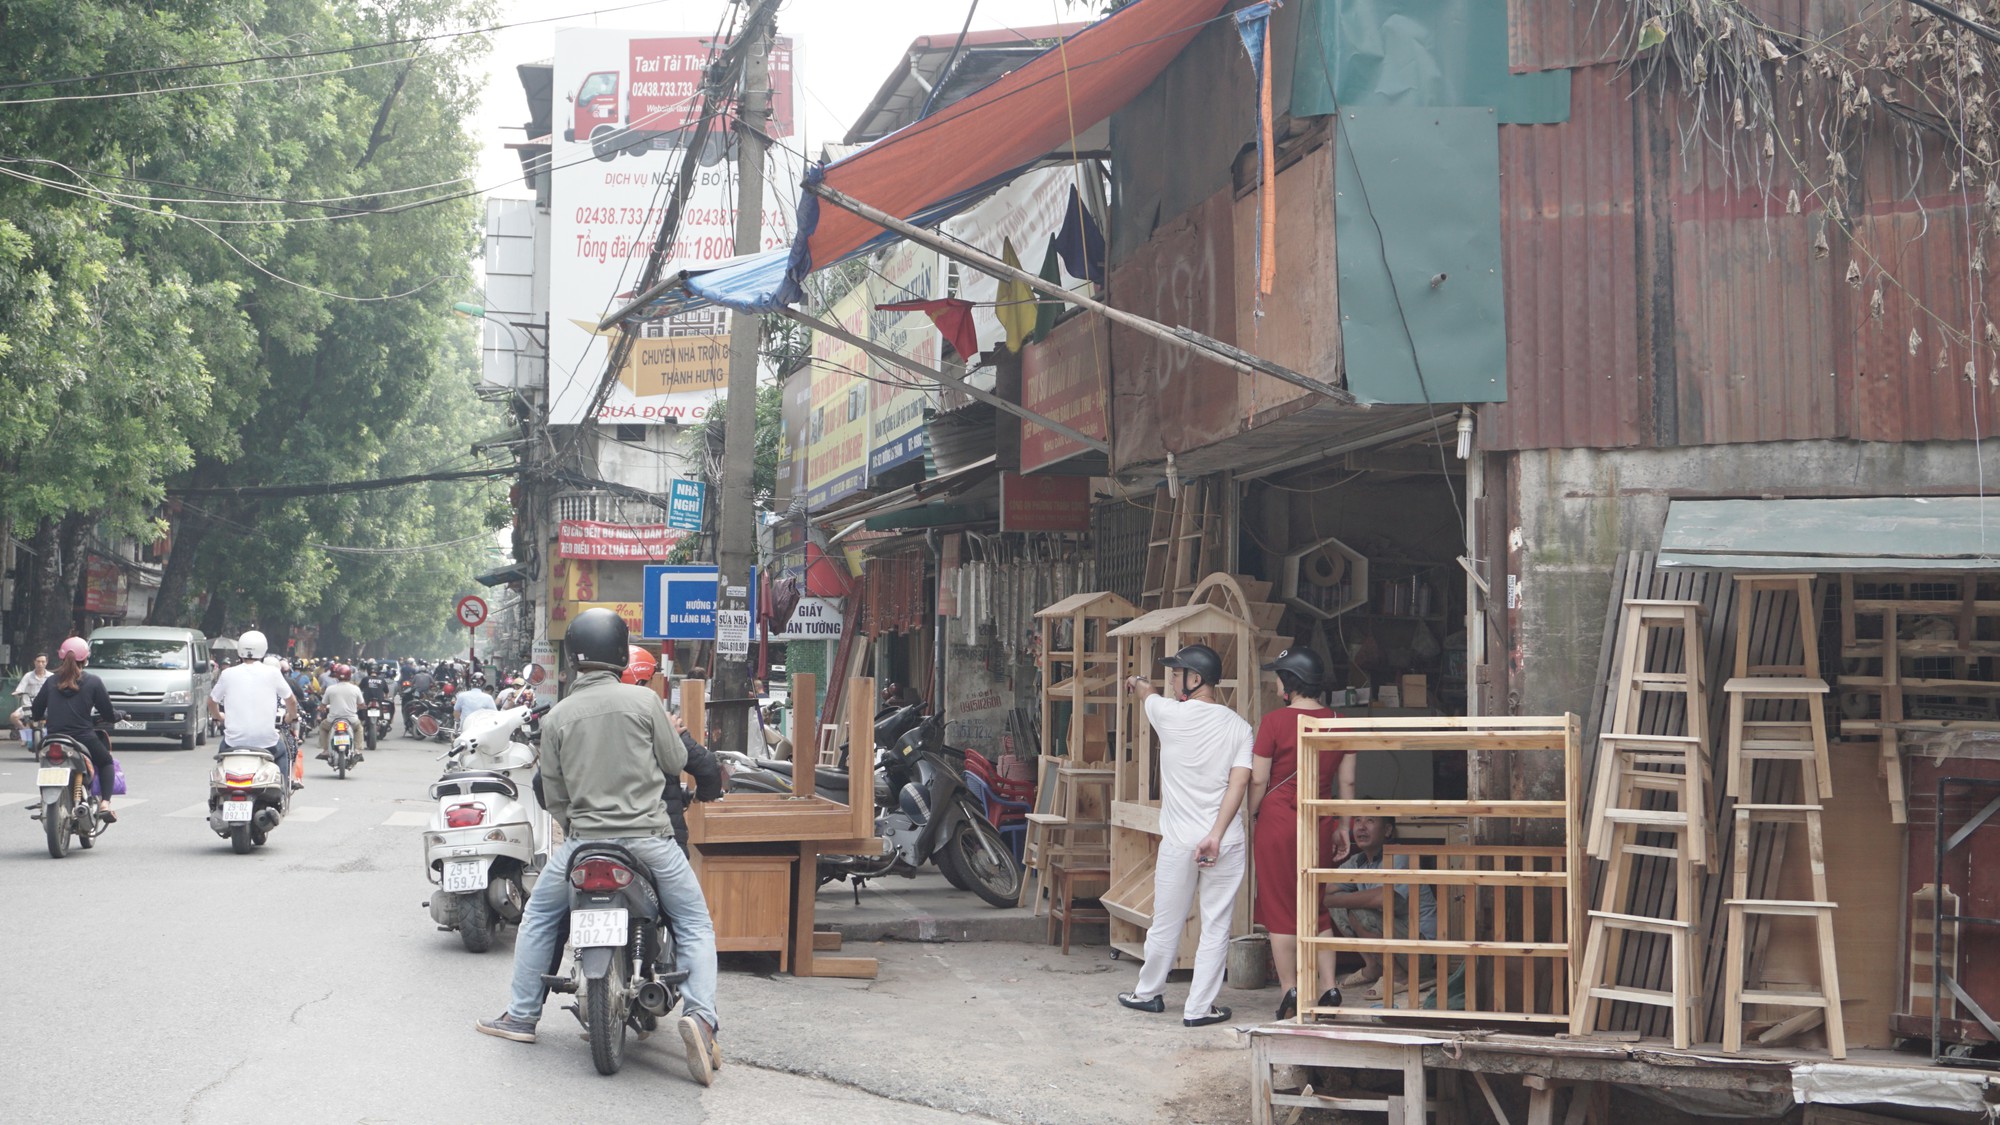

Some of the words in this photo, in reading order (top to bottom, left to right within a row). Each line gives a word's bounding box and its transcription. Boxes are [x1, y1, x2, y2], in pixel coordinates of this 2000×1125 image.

[635, 56, 660, 73] Taxi
[663, 54, 682, 72] Tải
[632, 82, 693, 97] 02438.733.733
[605, 173, 630, 188] DỊCH
[634, 173, 648, 188] VỤ
[577, 229, 608, 264] Tổng
[611, 234, 632, 258] đài
[677, 342, 696, 364] NHÀ
[661, 367, 693, 386] THÀNH
[695, 367, 724, 383] HƯNG
[643, 405, 686, 418] ĐƠN
[676, 483, 699, 497] NHÀ
[673, 497, 701, 513] NGHỈ
[591, 544, 607, 555] 112
[608, 542, 629, 558] LUẬT
[615, 604, 635, 617] Hoa
[685, 598, 711, 610] HƯỚNG
[798, 601, 823, 617] GIẤY
[670, 614, 679, 623] ĐI
[679, 612, 699, 623] LÁNG
[700, 614, 711, 626] HẠ
[718, 611, 732, 625] SỬA
[734, 612, 748, 625] NHÀ
[787, 620, 802, 634] ÁN
[805, 619, 841, 634] TƯỜNG
[224, 811, 250, 820] 092.11
[450, 862, 480, 877] 29-E1
[447, 875, 484, 890] 159.74
[579, 911, 619, 928] 29-Z1
[574, 928, 622, 945] 302.71
